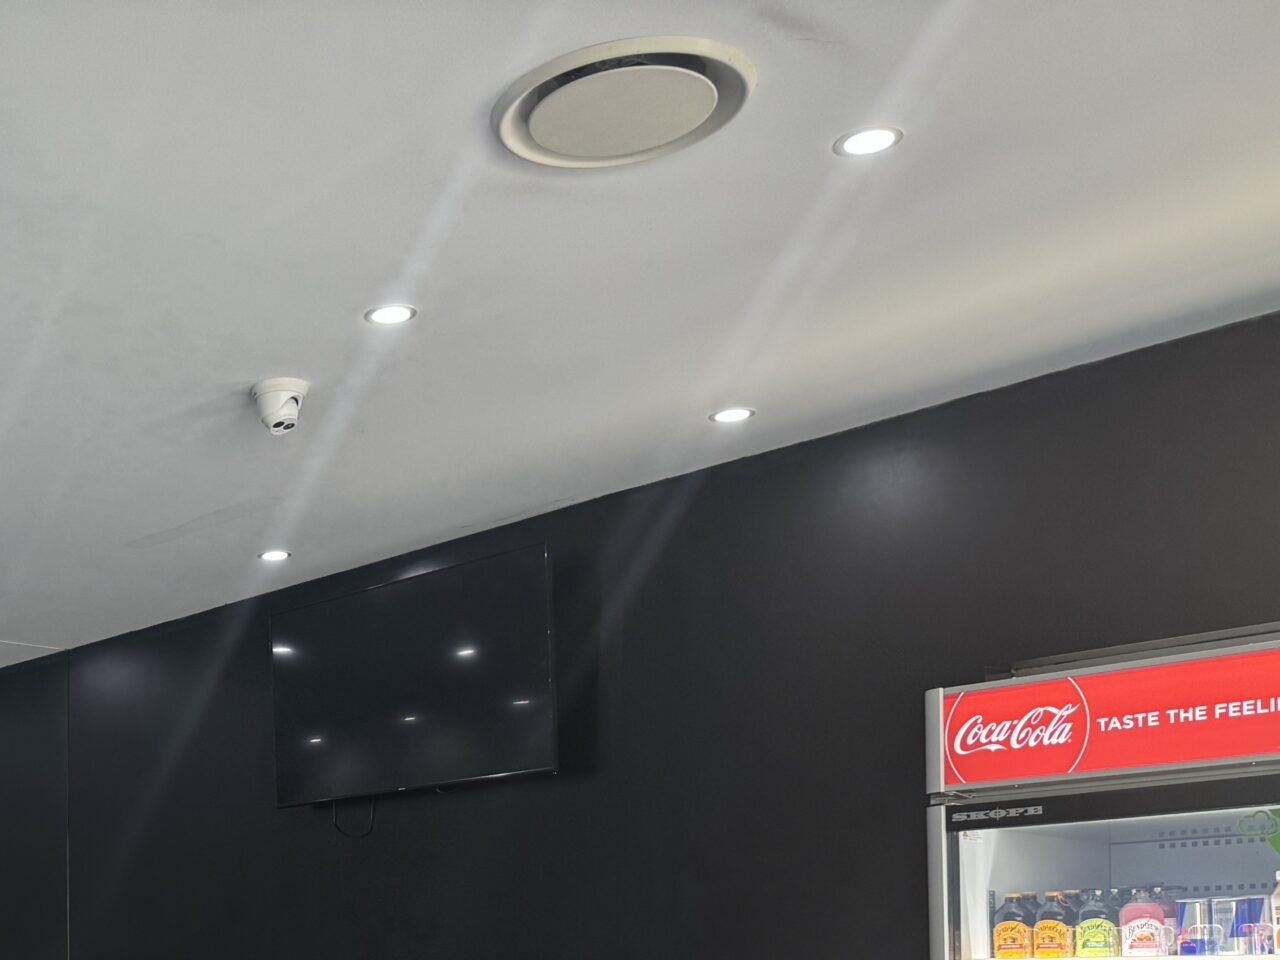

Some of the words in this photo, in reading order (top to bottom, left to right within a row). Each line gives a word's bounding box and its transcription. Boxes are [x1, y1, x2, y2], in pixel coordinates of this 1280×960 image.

[953, 703, 1081, 755] Coca-Cola
[1096, 711, 1160, 732] TASTE
[1165, 705, 1208, 724] THE
